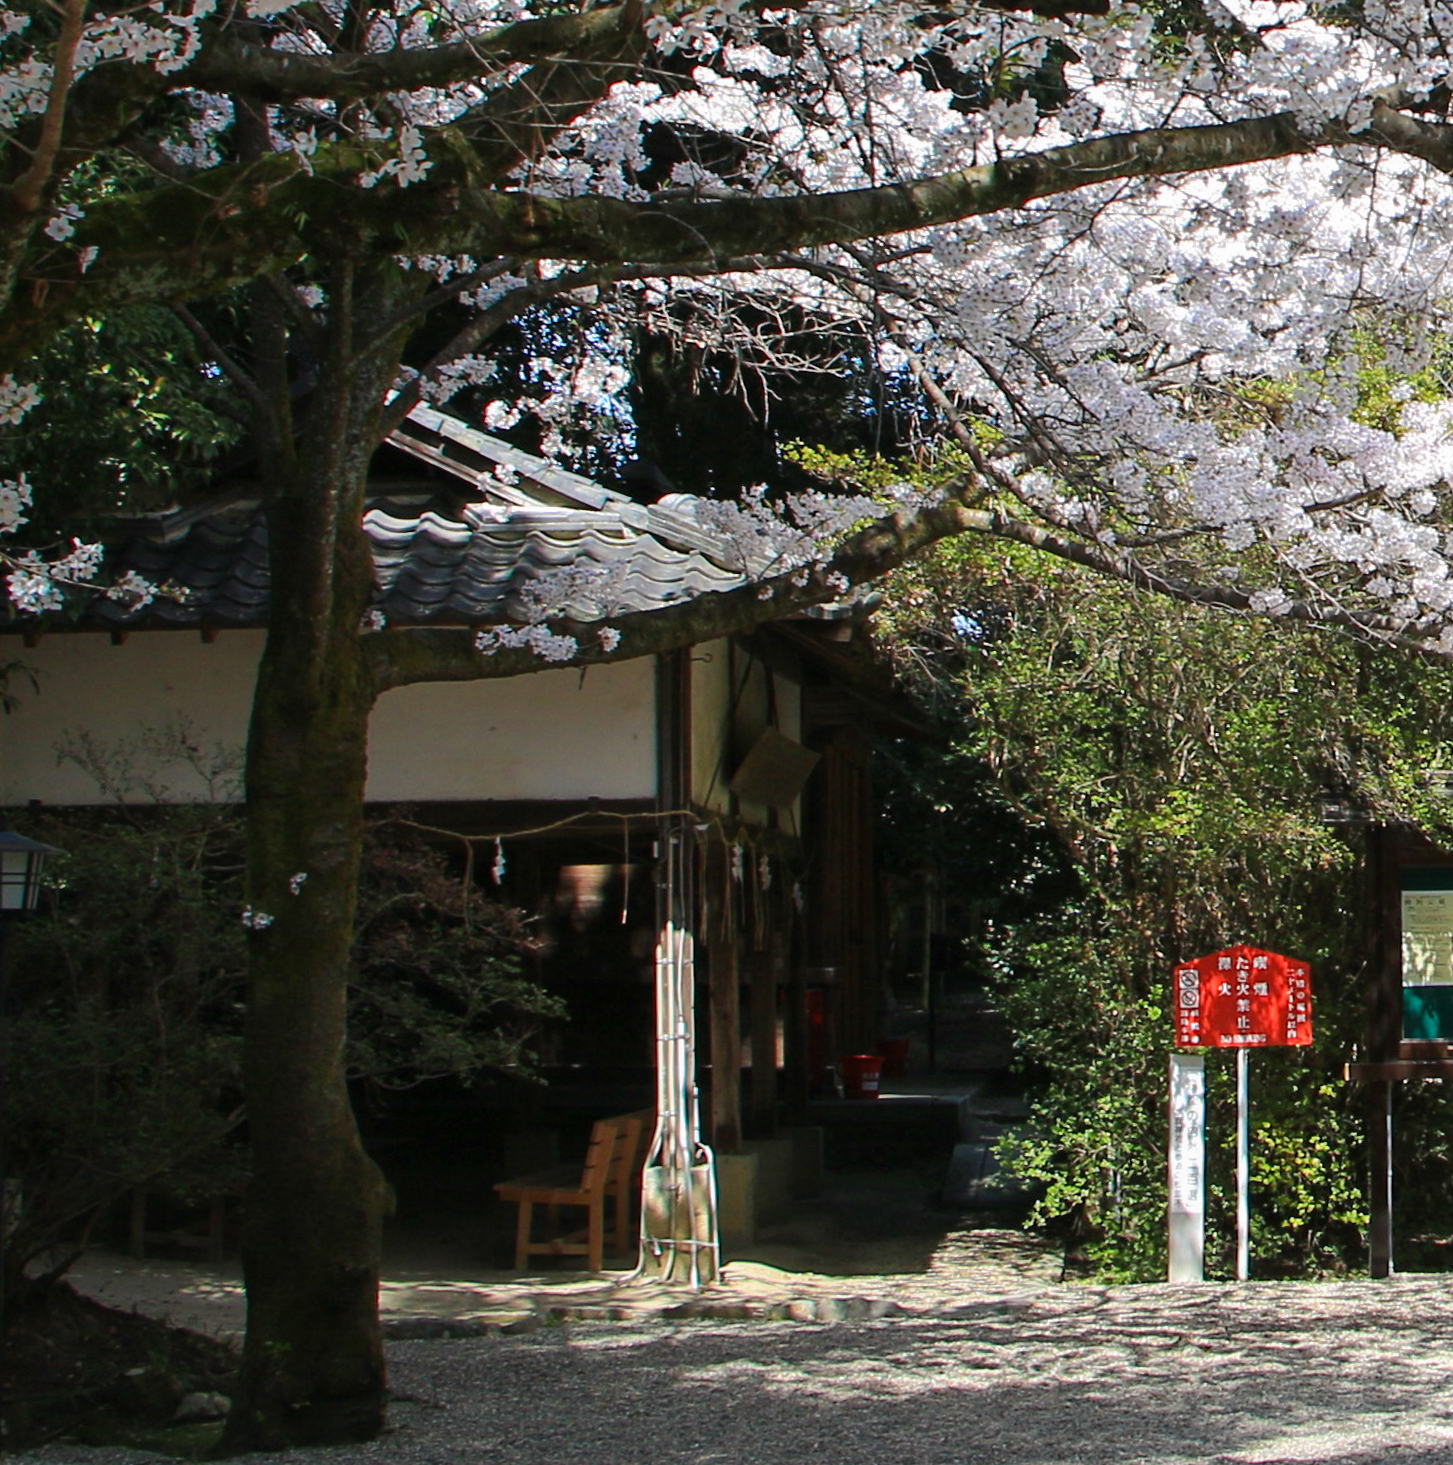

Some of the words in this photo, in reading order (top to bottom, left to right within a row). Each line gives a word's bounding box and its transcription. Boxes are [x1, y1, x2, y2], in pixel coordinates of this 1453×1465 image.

[1217, 956, 1232, 996] 裸火
[1235, 956, 1251, 1030] たき火禁止
[1252, 955, 1268, 996] 喫煙
